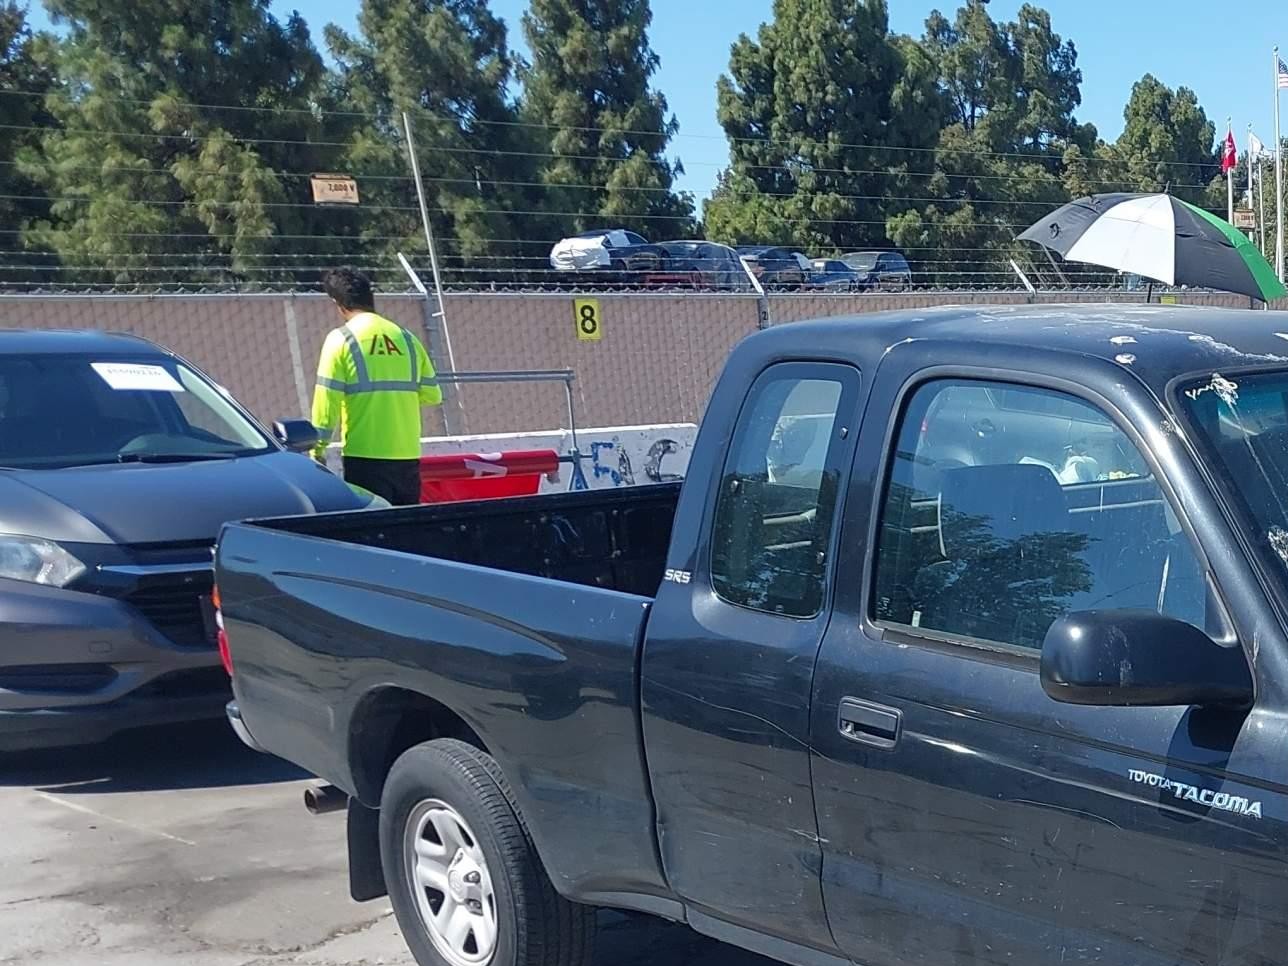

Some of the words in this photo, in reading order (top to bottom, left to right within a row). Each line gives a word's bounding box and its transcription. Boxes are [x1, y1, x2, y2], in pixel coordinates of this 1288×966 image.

[580, 304, 597, 335] 8
[1128, 769, 1172, 790] TOYOTA
[1170, 780, 1263, 819] TACOMA
